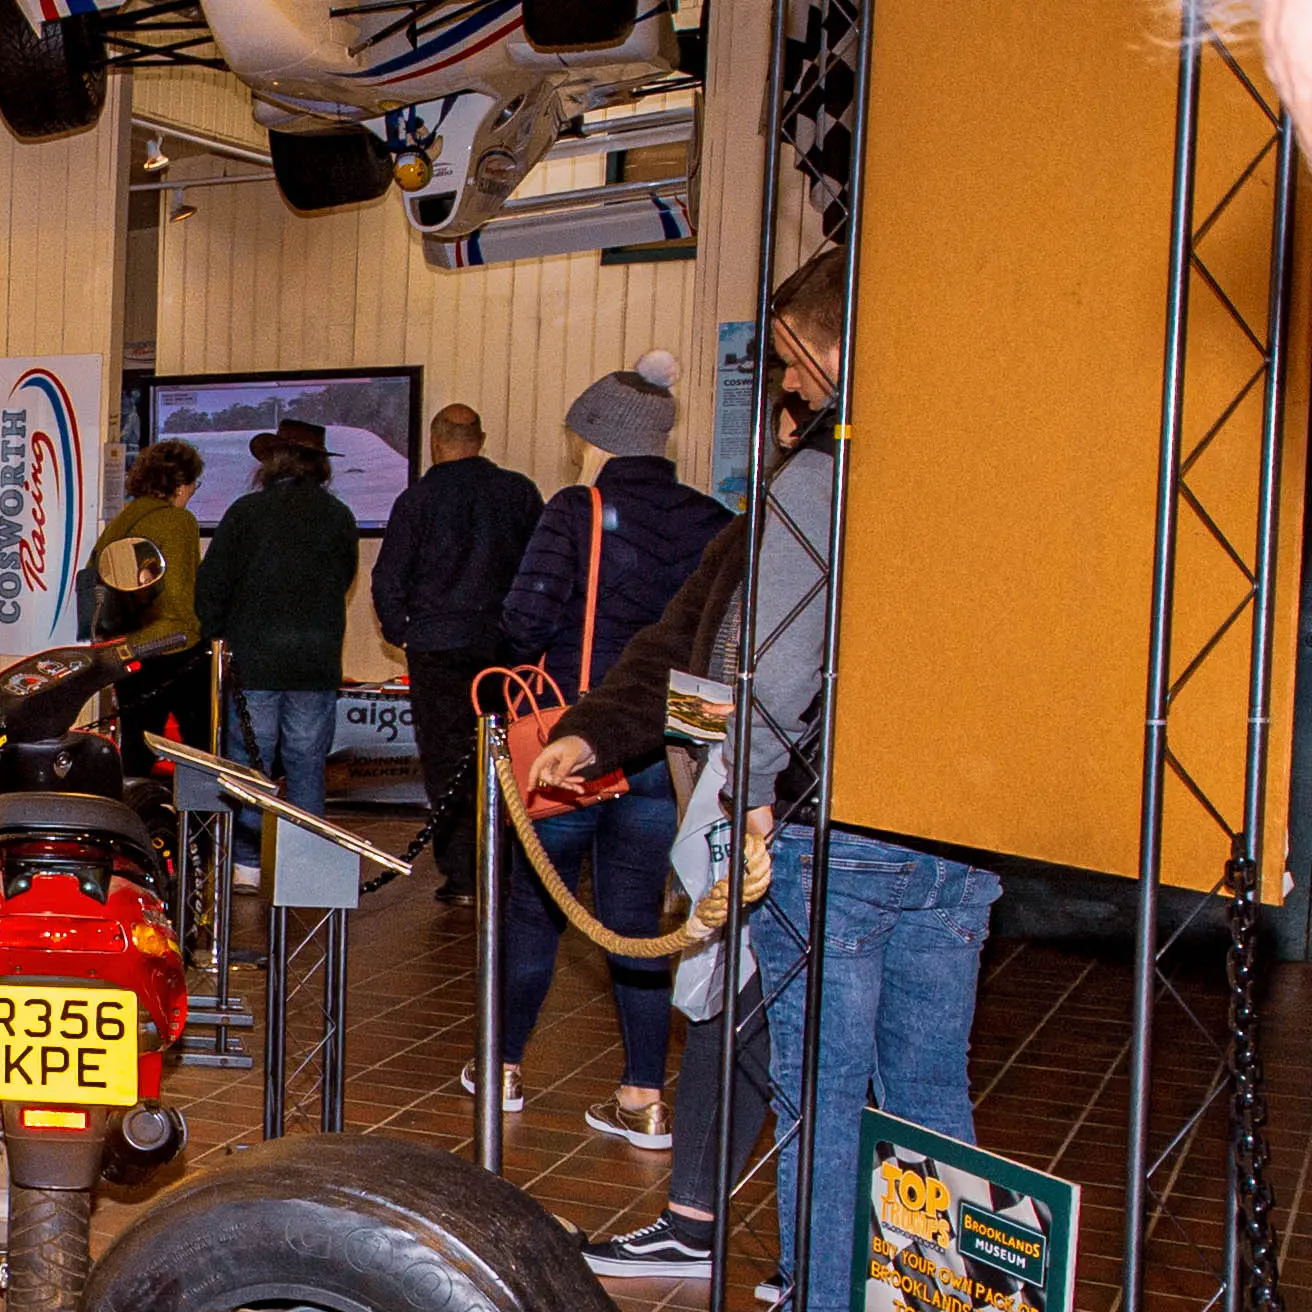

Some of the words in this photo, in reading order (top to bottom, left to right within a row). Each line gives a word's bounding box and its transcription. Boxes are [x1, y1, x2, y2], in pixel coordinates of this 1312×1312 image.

[19, 430, 60, 592] Racing
[4, 1044, 108, 1089] KPE
[880, 1161, 951, 1219] TOP
[880, 1195, 951, 1250] TRUMPS
[964, 1213, 1041, 1258] BROOKLANDS
[872, 1236, 897, 1256] BUY
[901, 1249, 935, 1274] YOUR
[940, 1266, 973, 1295] OWN
[975, 1237, 1026, 1268] MUSEUM
